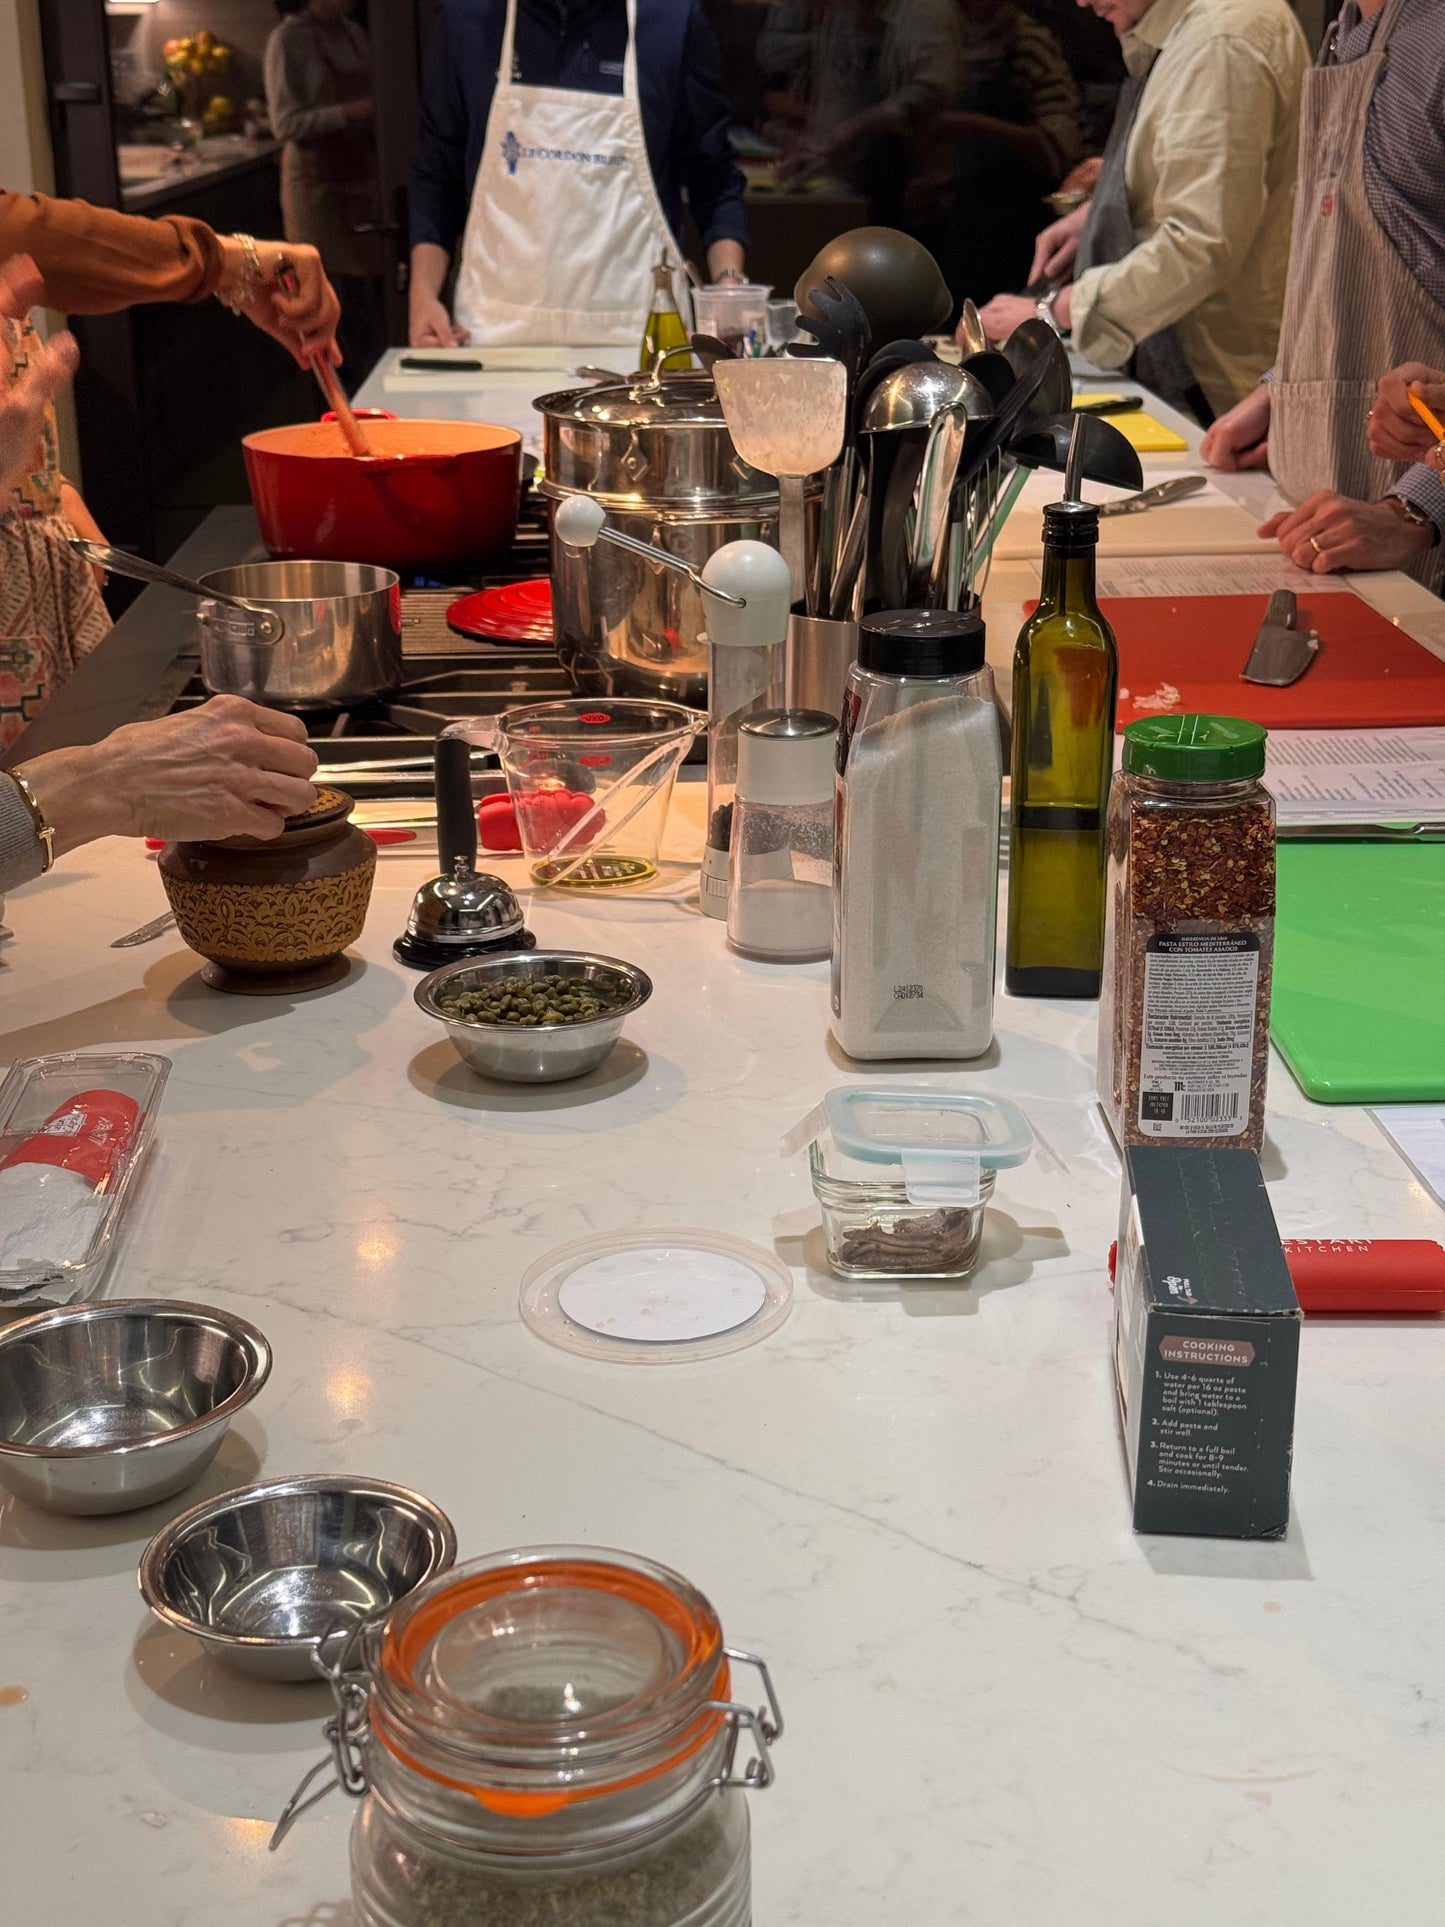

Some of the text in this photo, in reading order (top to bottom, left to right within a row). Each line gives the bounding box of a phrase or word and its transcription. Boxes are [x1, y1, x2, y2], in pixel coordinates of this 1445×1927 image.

[1284, 1245, 1369, 1254] KITCHEN
[1182, 1341, 1235, 1352] COOKING
[1164, 1350, 1248, 1363] INSTRUCTIONS
[1164, 1372, 1179, 1380] Use
[1181, 1374, 1197, 1382] 4-6
[1180, 1390, 1199, 1399] bring
[1202, 1383, 1211, 1391] 16
[1224, 1386, 1246, 1394] pasta
[1162, 1396, 1177, 1404] boil
[1204, 1400, 1247, 1409] tablespoon
[1152, 1418, 1160, 1426] 2.
[1180, 1422, 1201, 1430] pasta
[1203, 1423, 1218, 1431] and
[1150, 1441, 1158, 1449] 3.
[1160, 1442, 1187, 1451] Return
[1205, 1445, 1219, 1454] full
[1220, 1447, 1236, 1455] boil
[1159, 1450, 1224, 1462] and cook for 8-9
[1158, 1459, 1190, 1467] minutes
[1202, 1462, 1220, 1470] until
[1221, 1464, 1249, 1472] tender.
[1174, 1469, 1223, 1478] occasionally.
[1147, 1479, 1230, 1494] 4. Drain immediately.
